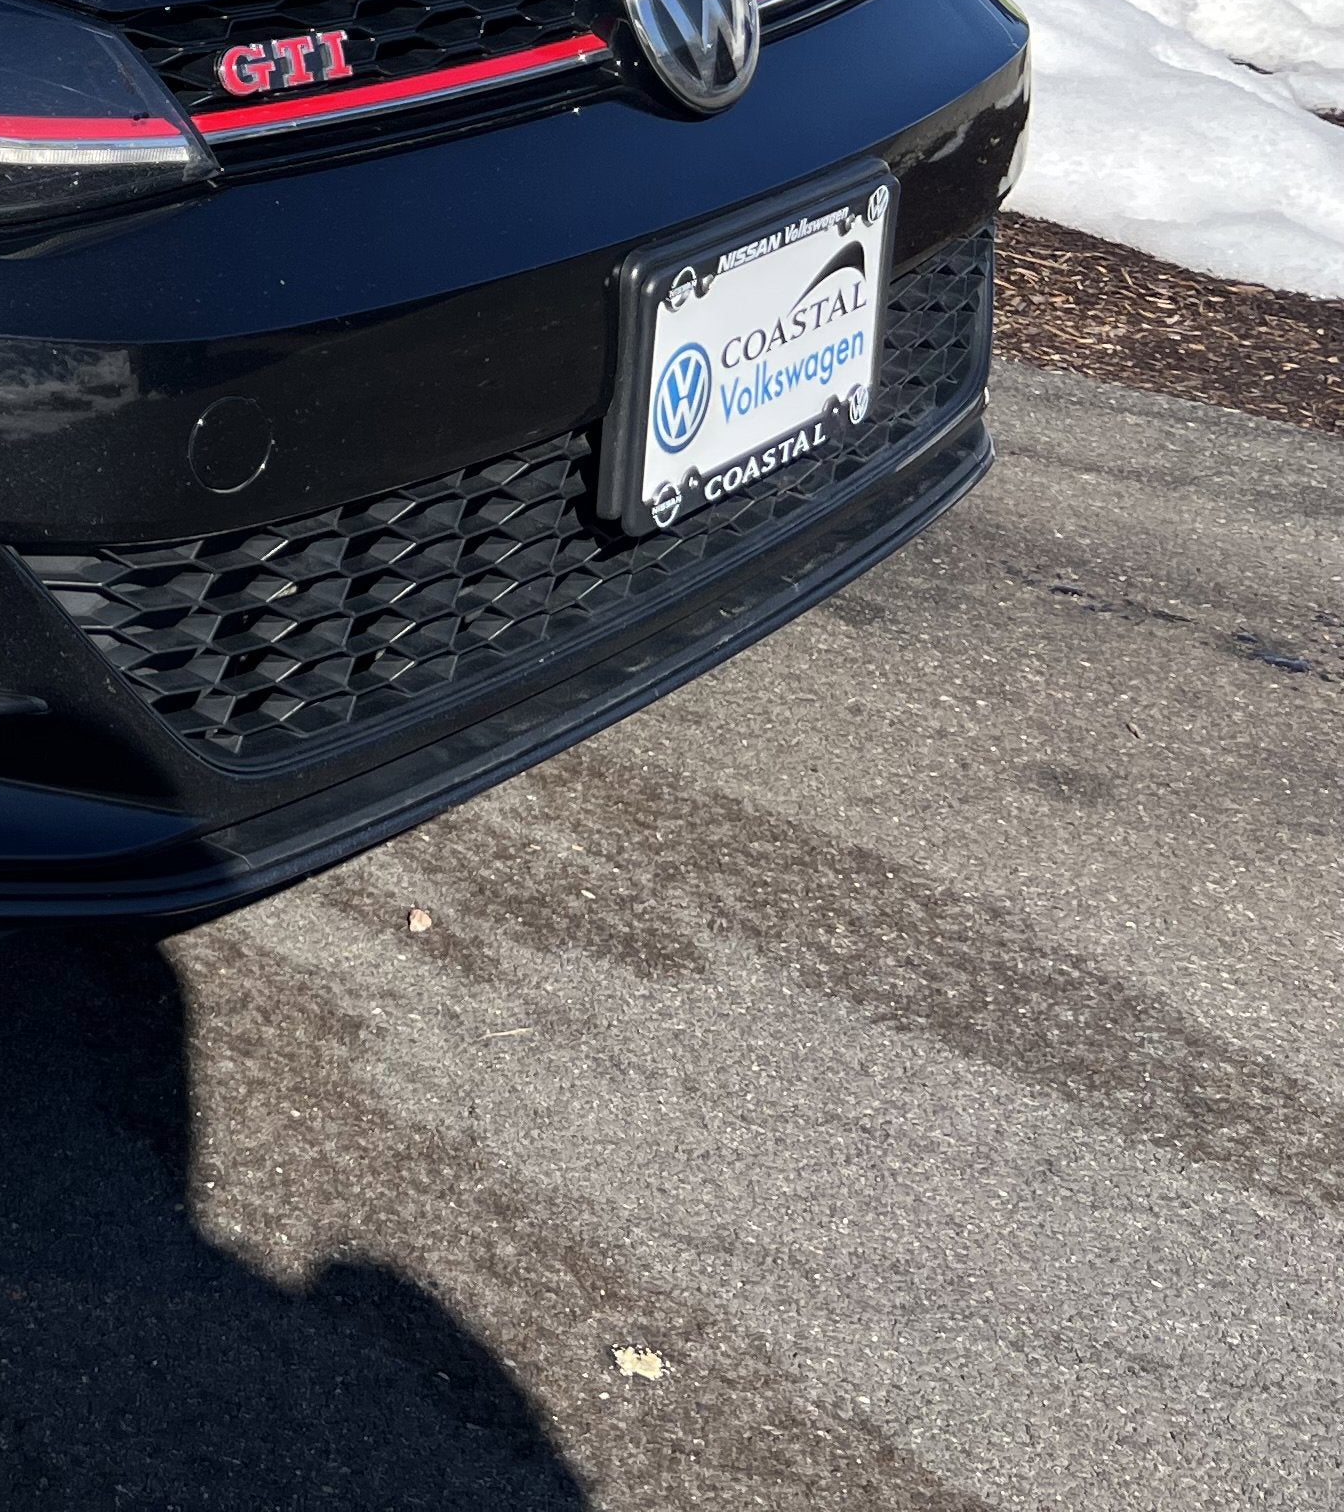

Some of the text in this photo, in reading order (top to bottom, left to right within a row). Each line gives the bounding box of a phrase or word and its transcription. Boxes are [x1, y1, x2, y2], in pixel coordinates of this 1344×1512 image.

[217, 31, 353, 96] GTI
[716, 206, 849, 274] NISSAN Volkswagen
[721, 281, 868, 370] COASTAL
[719, 329, 865, 423] Volkswagen
[704, 420, 827, 502] COASTAL
